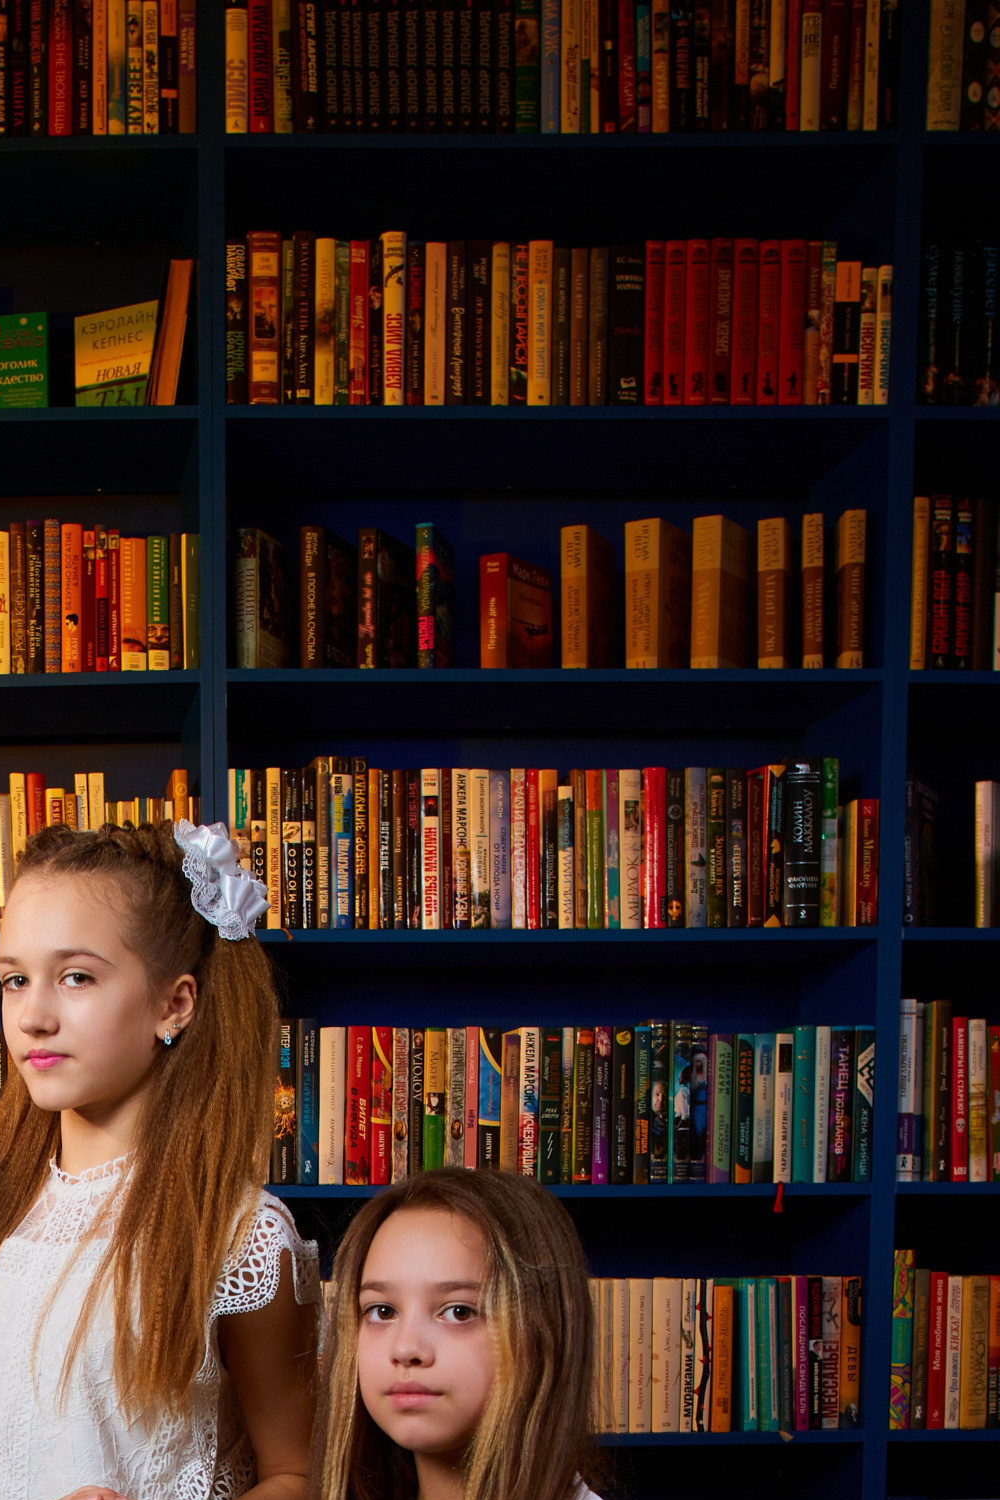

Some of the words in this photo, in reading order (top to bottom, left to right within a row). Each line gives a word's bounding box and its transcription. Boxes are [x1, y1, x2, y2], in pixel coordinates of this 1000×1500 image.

[54, 43, 66, 51] Я
[54, 54, 66, 68] НЕ
[54, 70, 67, 99] ТВОЯ
[55, 101, 67, 133] ВЕЩЬ
[226, 245, 236, 292] ЛАВКРАФТ
[236, 245, 245, 279] ГОВАРД
[516, 245, 527, 263] НЕ
[80, 311, 155, 336] КЭРОЛАЙН
[386, 313, 401, 345] ЛИСС
[515, 267, 527, 364] ПРОСЫПАЙСЯ
[92, 331, 143, 351] КЕПНЕС
[861, 327, 874, 390] МАКЬЮЭН
[95, 363, 141, 382] НОВАЯ
[387, 349, 401, 389] ДЭВИД
[307, 578, 315, 609] ПОГОНЕ
[307, 610, 315, 621] ЗА
[307, 623, 316, 660] СЧАСТЬЕМ
[355, 774, 366, 832] ЗИГМУНДА
[456, 773, 466, 804] АНЖЕЛА
[456, 808, 466, 849] МАРСОНС
[793, 801, 804, 842] КОЛИН
[804, 789, 814, 853] МАККАЛОУ
[271, 847, 279, 872] ЖИЗНЬ
[319, 846, 329, 888] МАРКЛУНД
[338, 839, 349, 890] МАРКЛУНД
[356, 838, 366, 875] ВЫБОР
[424, 827, 437, 872] МАКЛИН
[271, 874, 279, 888] КАК
[288, 849, 297, 902] МЮССО
[271, 890, 279, 914] РОМАН
[319, 889, 329, 909] ЛИЗА
[338, 892, 349, 916] ЛИЗА
[425, 876, 438, 916] ЧАРЛЬЗ
[524, 1032, 535, 1063] АНЖЕЛА
[413, 1053, 423, 1102] ДОРОГА
[524, 1066, 535, 1106] МАРСОНС
[839, 1046, 849, 1090] ТАНЕЦ
[835, 1092, 845, 1154] ТЮЛЬПАНОВ
[523, 1113, 535, 1176] ИСЧЕЗНУВШИЕ
[934, 1279, 944, 1303] жена
[933, 1305, 944, 1348] любимая
[933, 1351, 943, 1370] Моя
[683, 1355, 693, 1418] мураками
